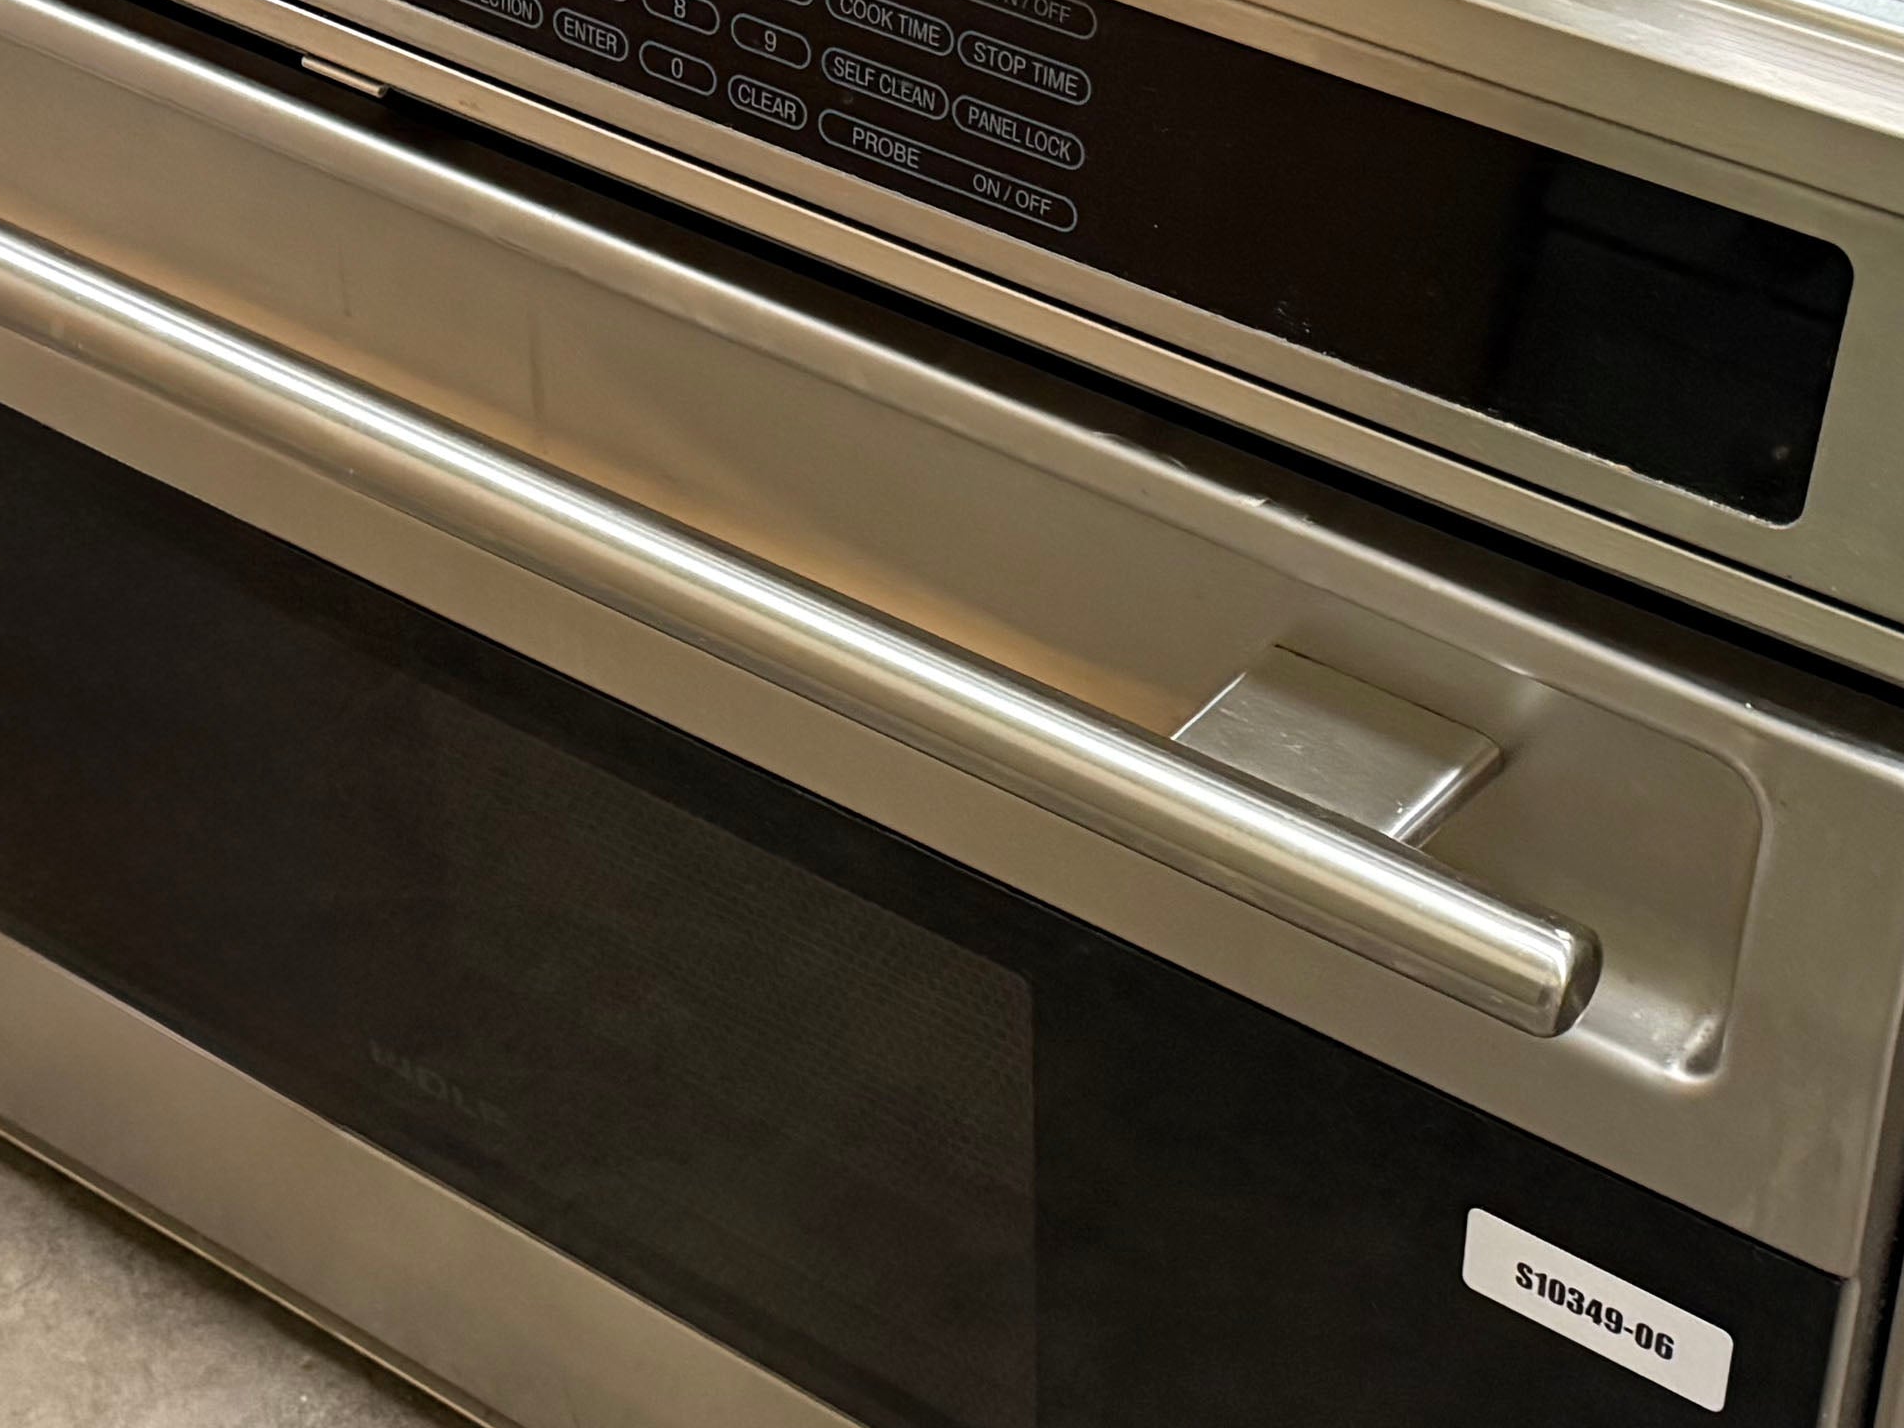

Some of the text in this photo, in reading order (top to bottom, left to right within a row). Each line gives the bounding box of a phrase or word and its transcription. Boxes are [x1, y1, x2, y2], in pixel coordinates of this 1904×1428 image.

[565, 17, 617, 53] ENTER
[765, 31, 777, 52] 9
[898, 15, 939, 46] TIME
[671, 58, 683, 79] 0
[834, 57, 935, 111] SELF CLEAN
[974, 42, 1078, 97] STOP TIME
[738, 84, 796, 122] CLEAR
[969, 107, 1072, 161] PANEL LOCK
[852, 127, 920, 170] PROBE
[973, 174, 1000, 199] ON
[1015, 191, 1052, 216] OFF
[1516, 1262, 1674, 1361] S10349-06
